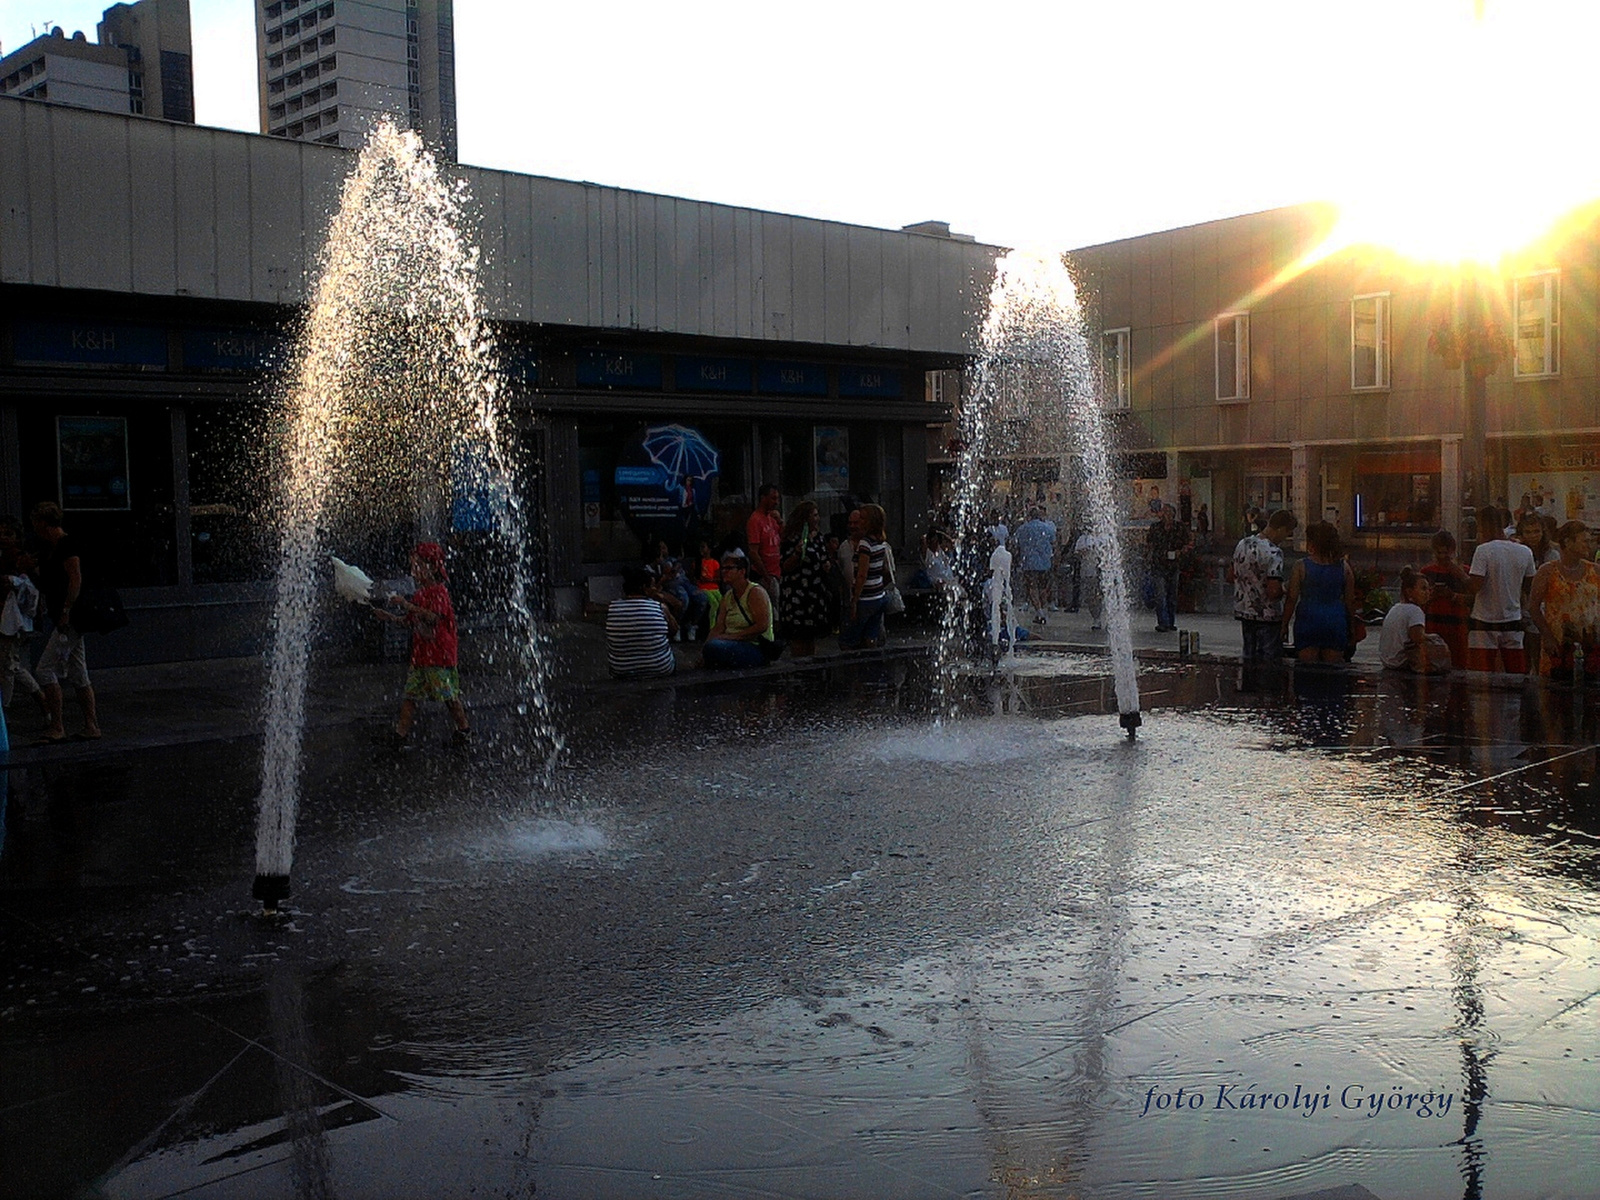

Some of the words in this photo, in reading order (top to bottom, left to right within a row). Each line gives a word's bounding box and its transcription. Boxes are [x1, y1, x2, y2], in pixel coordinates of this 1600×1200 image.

[71, 329, 115, 351] K&H
[216, 338, 256, 358] K&H
[605, 359, 634, 376] K&H
[700, 365, 727, 380] K&H
[780, 369, 804, 385] K&H
[860, 374, 881, 388] K&H
